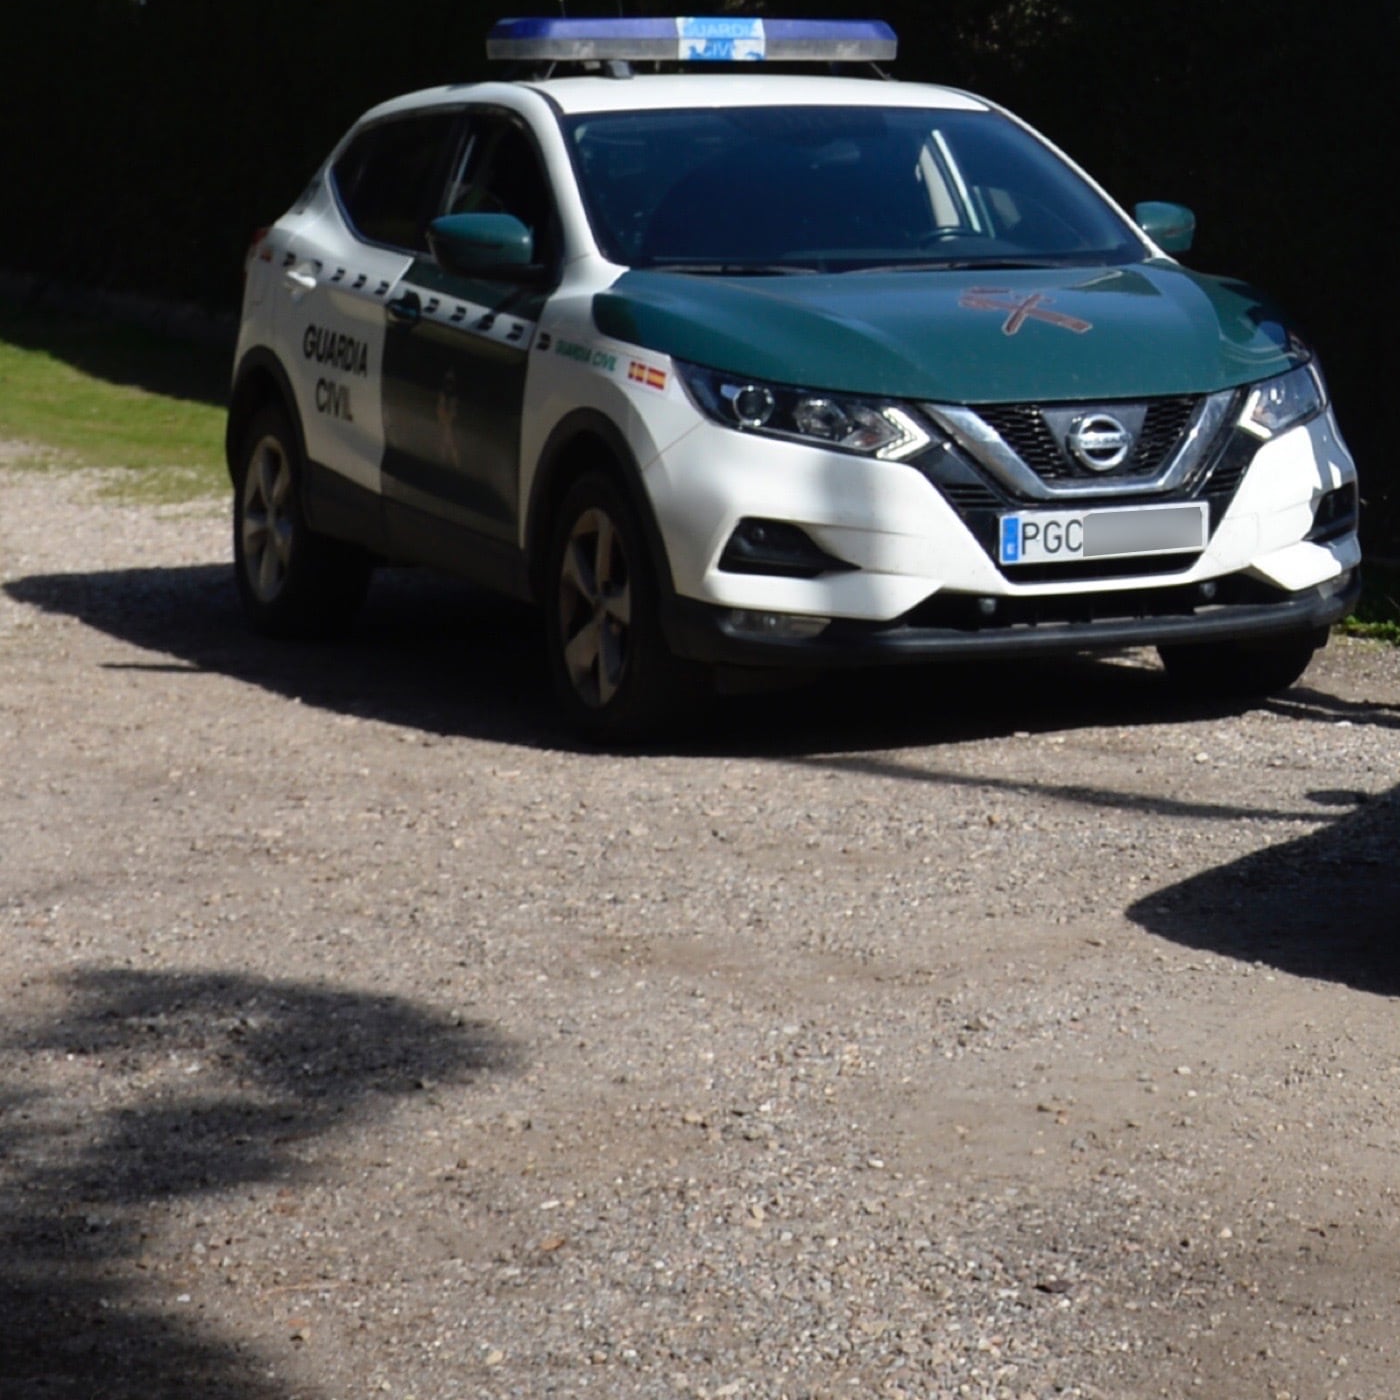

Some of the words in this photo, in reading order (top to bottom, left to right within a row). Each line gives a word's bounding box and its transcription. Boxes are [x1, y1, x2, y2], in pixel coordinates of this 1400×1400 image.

[303, 324, 368, 378] GUARDIA
[315, 377, 354, 423] CIVIL
[1021, 518, 1083, 556] PGC
